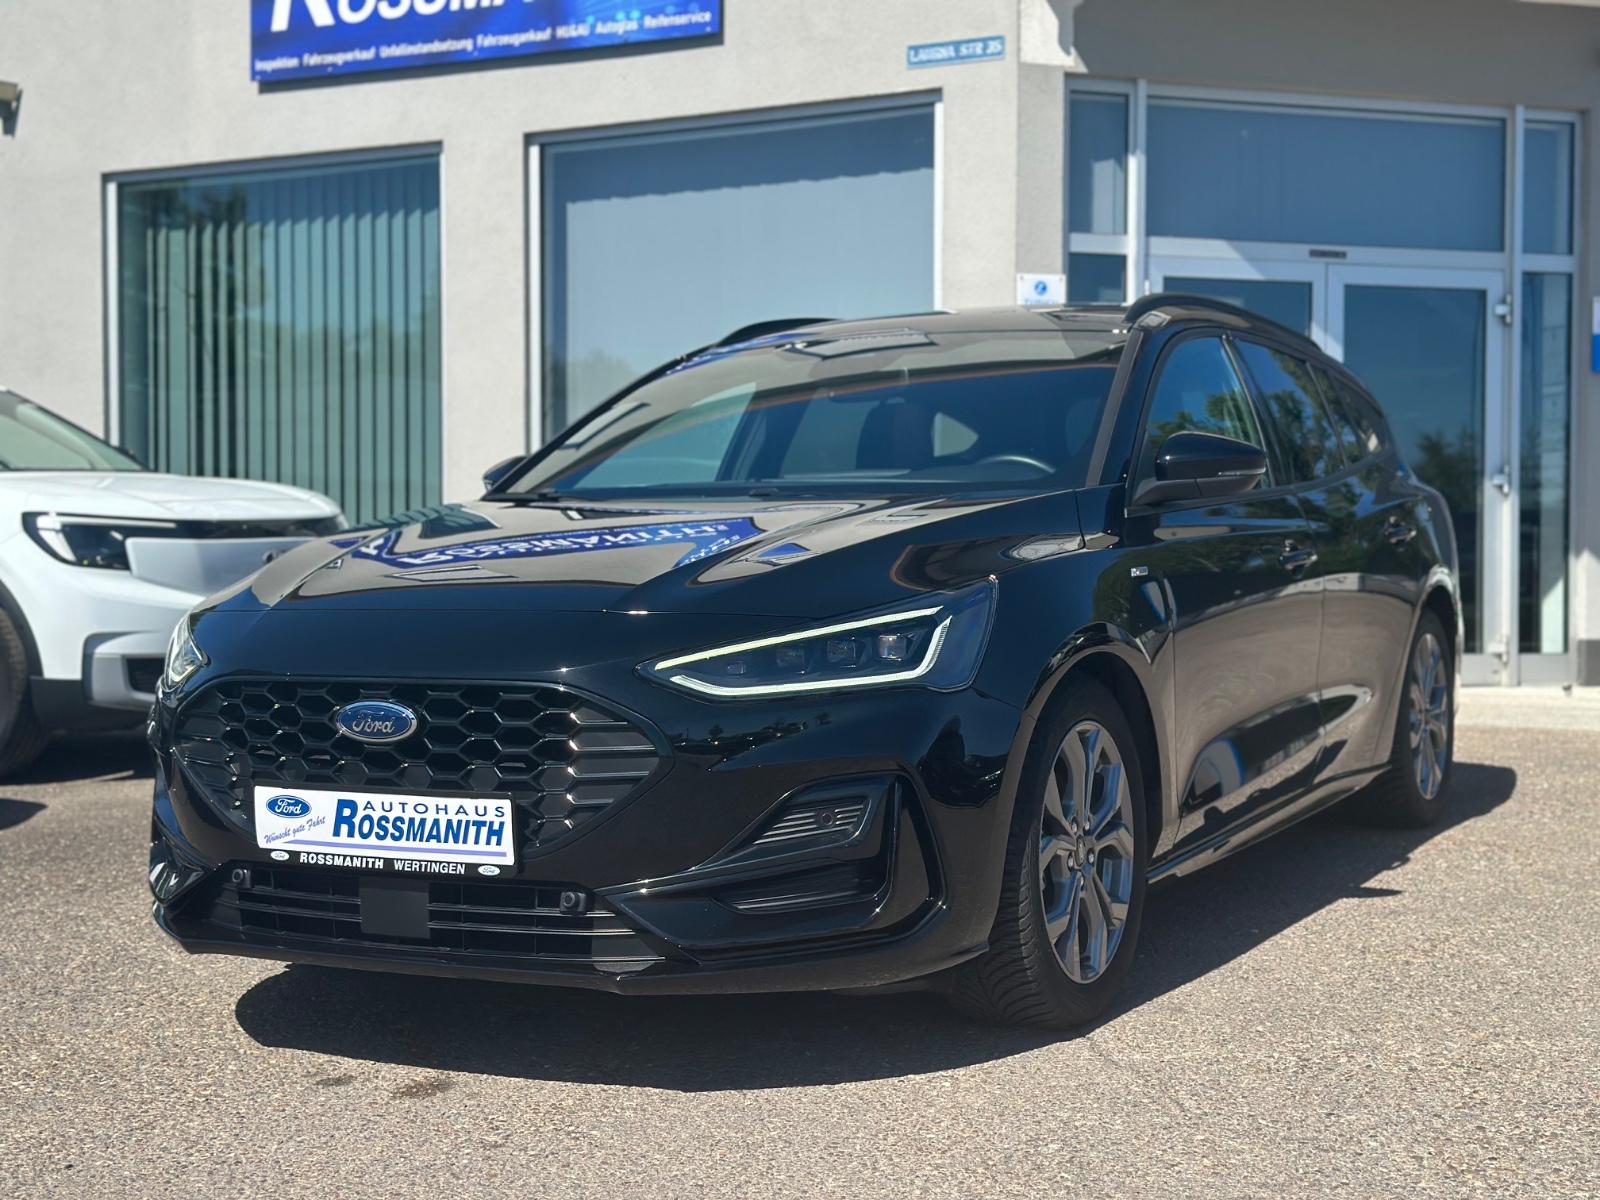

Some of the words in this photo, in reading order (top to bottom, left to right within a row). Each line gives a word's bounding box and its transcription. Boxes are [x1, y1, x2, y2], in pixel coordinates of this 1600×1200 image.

[352, 710, 396, 734] Ford
[275, 798, 302, 814] Ford
[363, 801, 505, 818] AUTOHAUS
[332, 799, 505, 847] ROSSMANITH
[300, 852, 384, 869] ROSSMANITH
[394, 860, 466, 875] WERTINGEN
